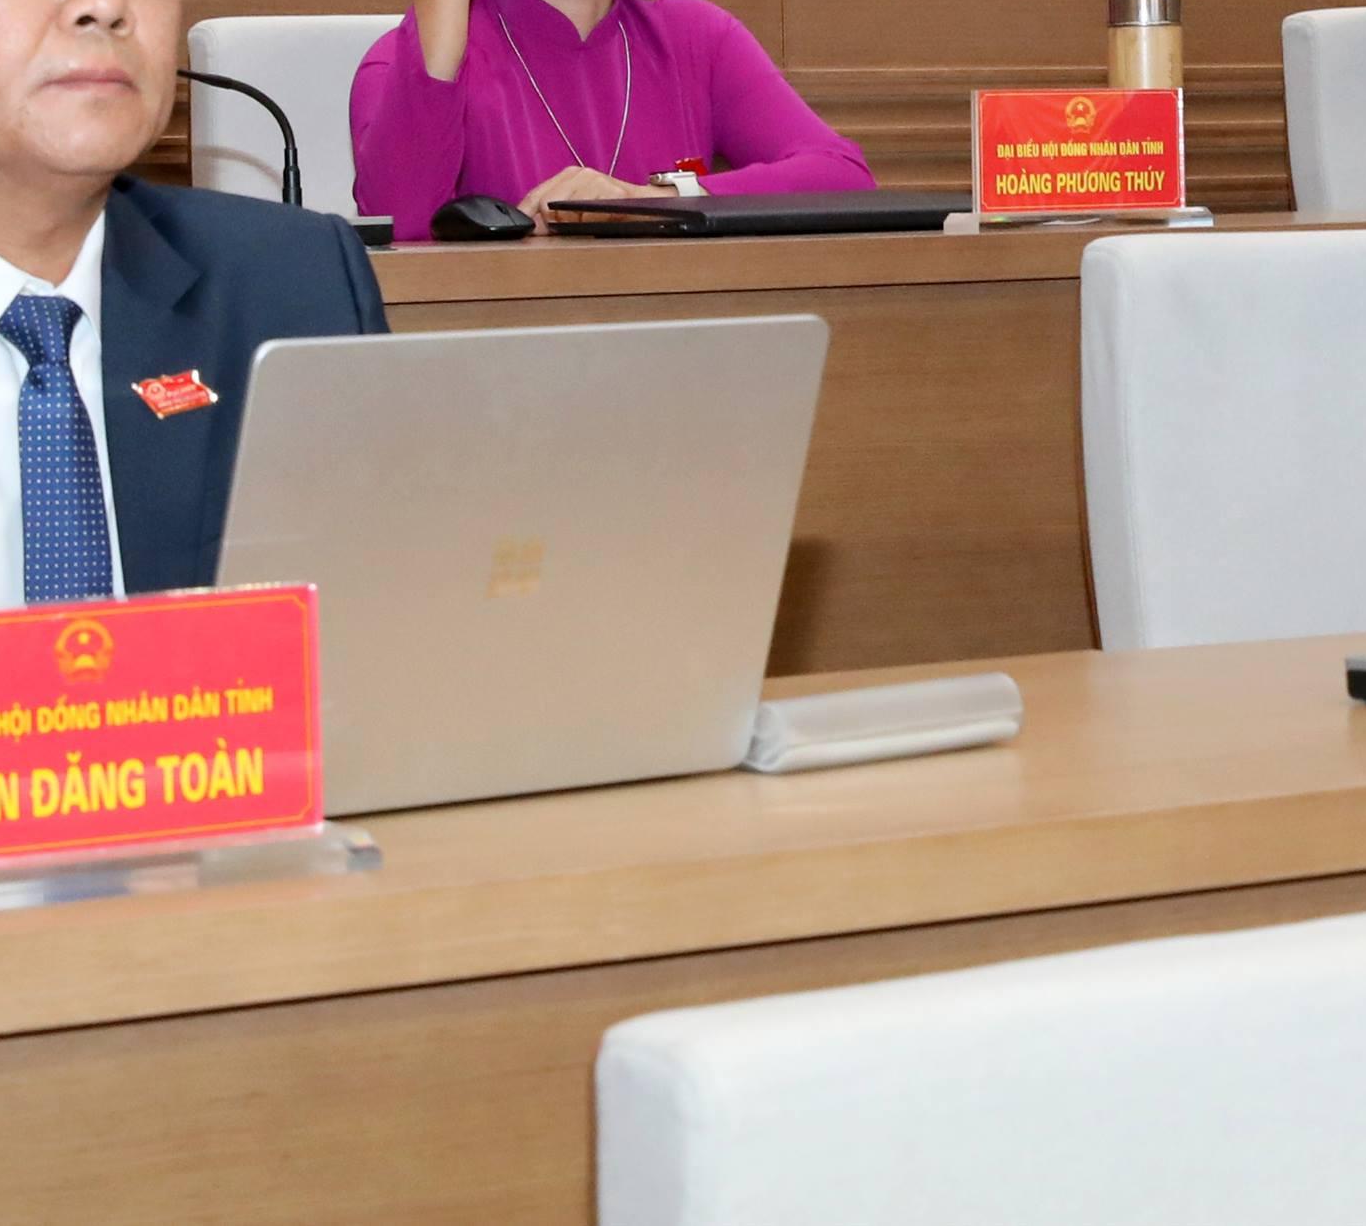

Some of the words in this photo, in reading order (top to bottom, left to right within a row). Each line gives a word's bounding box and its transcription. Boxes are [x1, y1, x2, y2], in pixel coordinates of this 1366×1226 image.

[996, 168, 1051, 194] HOÀNG
[1057, 170, 1121, 192] PHƯƠNG
[31, 752, 145, 818] ĐĂNG
[156, 739, 263, 804] TOÀN
